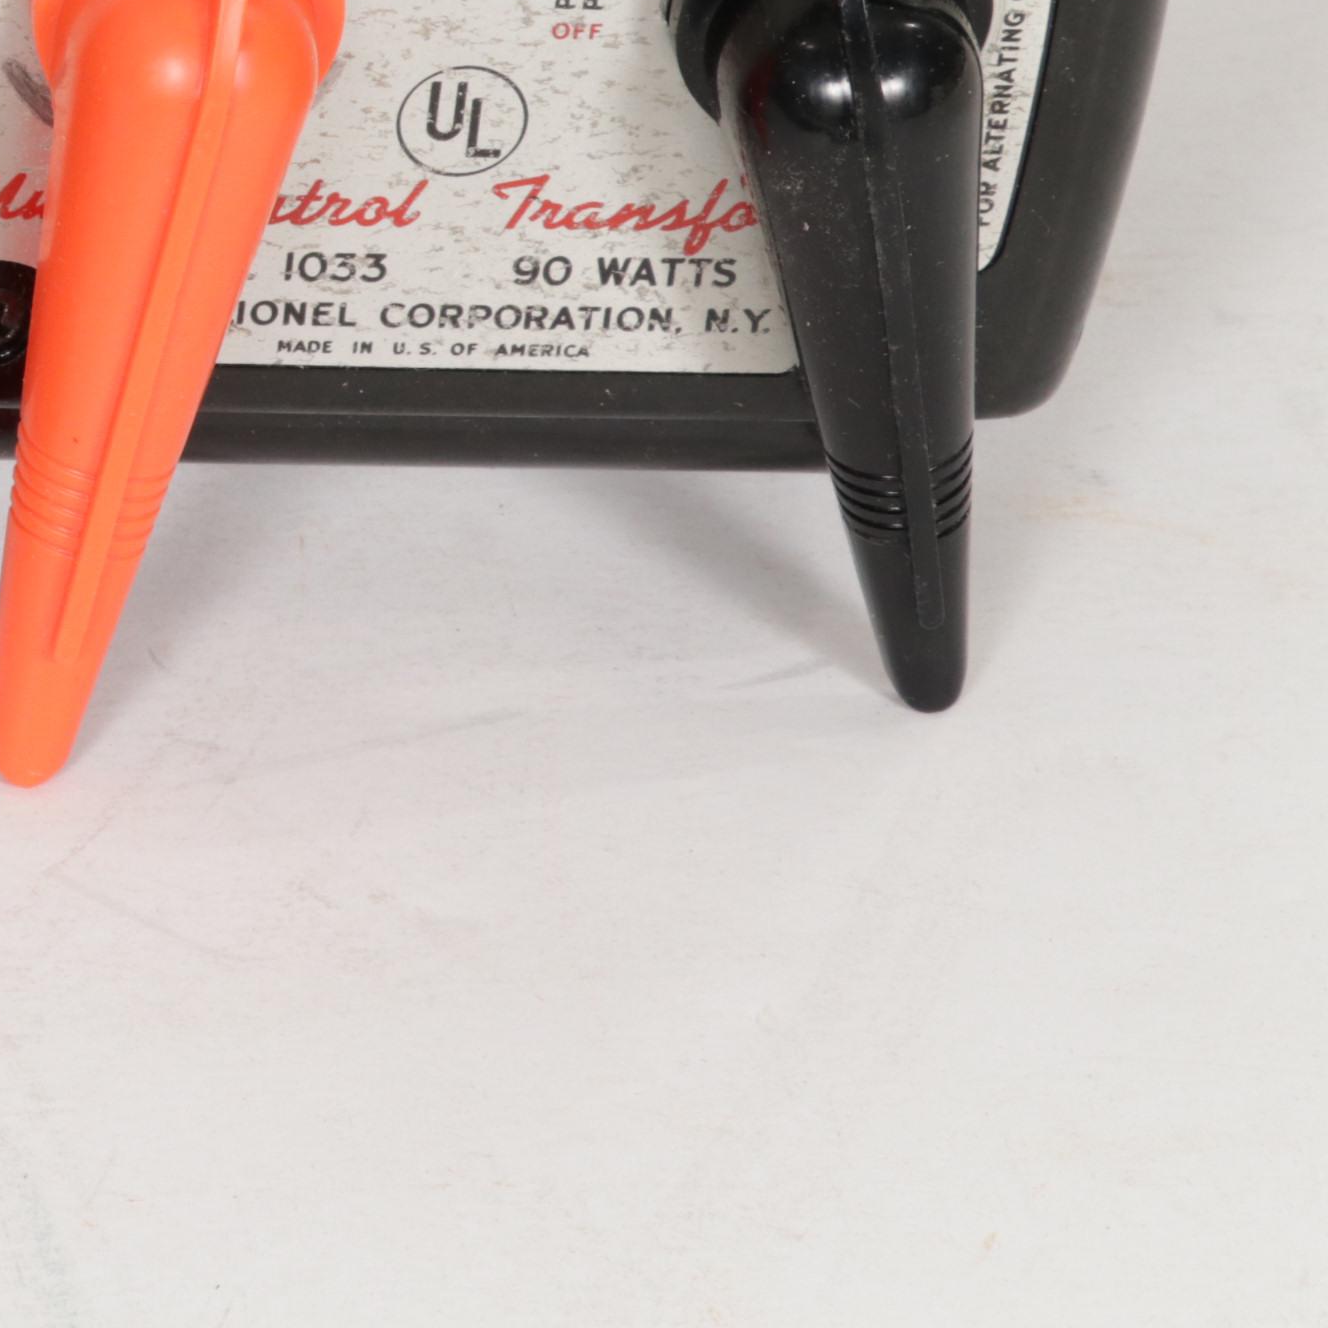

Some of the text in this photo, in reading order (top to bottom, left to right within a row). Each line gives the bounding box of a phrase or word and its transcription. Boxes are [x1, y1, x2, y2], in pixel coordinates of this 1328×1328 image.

[551, 23, 604, 41] OFF
[985, 10, 1026, 174] ALTERNATING
[426, 80, 502, 158] UL
[284, 252, 737, 288] 1033 90 WATTS
[232, 300, 771, 336] IONEL CORPORATION, N.Y.
[277, 340, 333, 354] MADE
[352, 341, 373, 354] IN
[450, 343, 477, 356] OF
[495, 343, 590, 359] AMERICA
